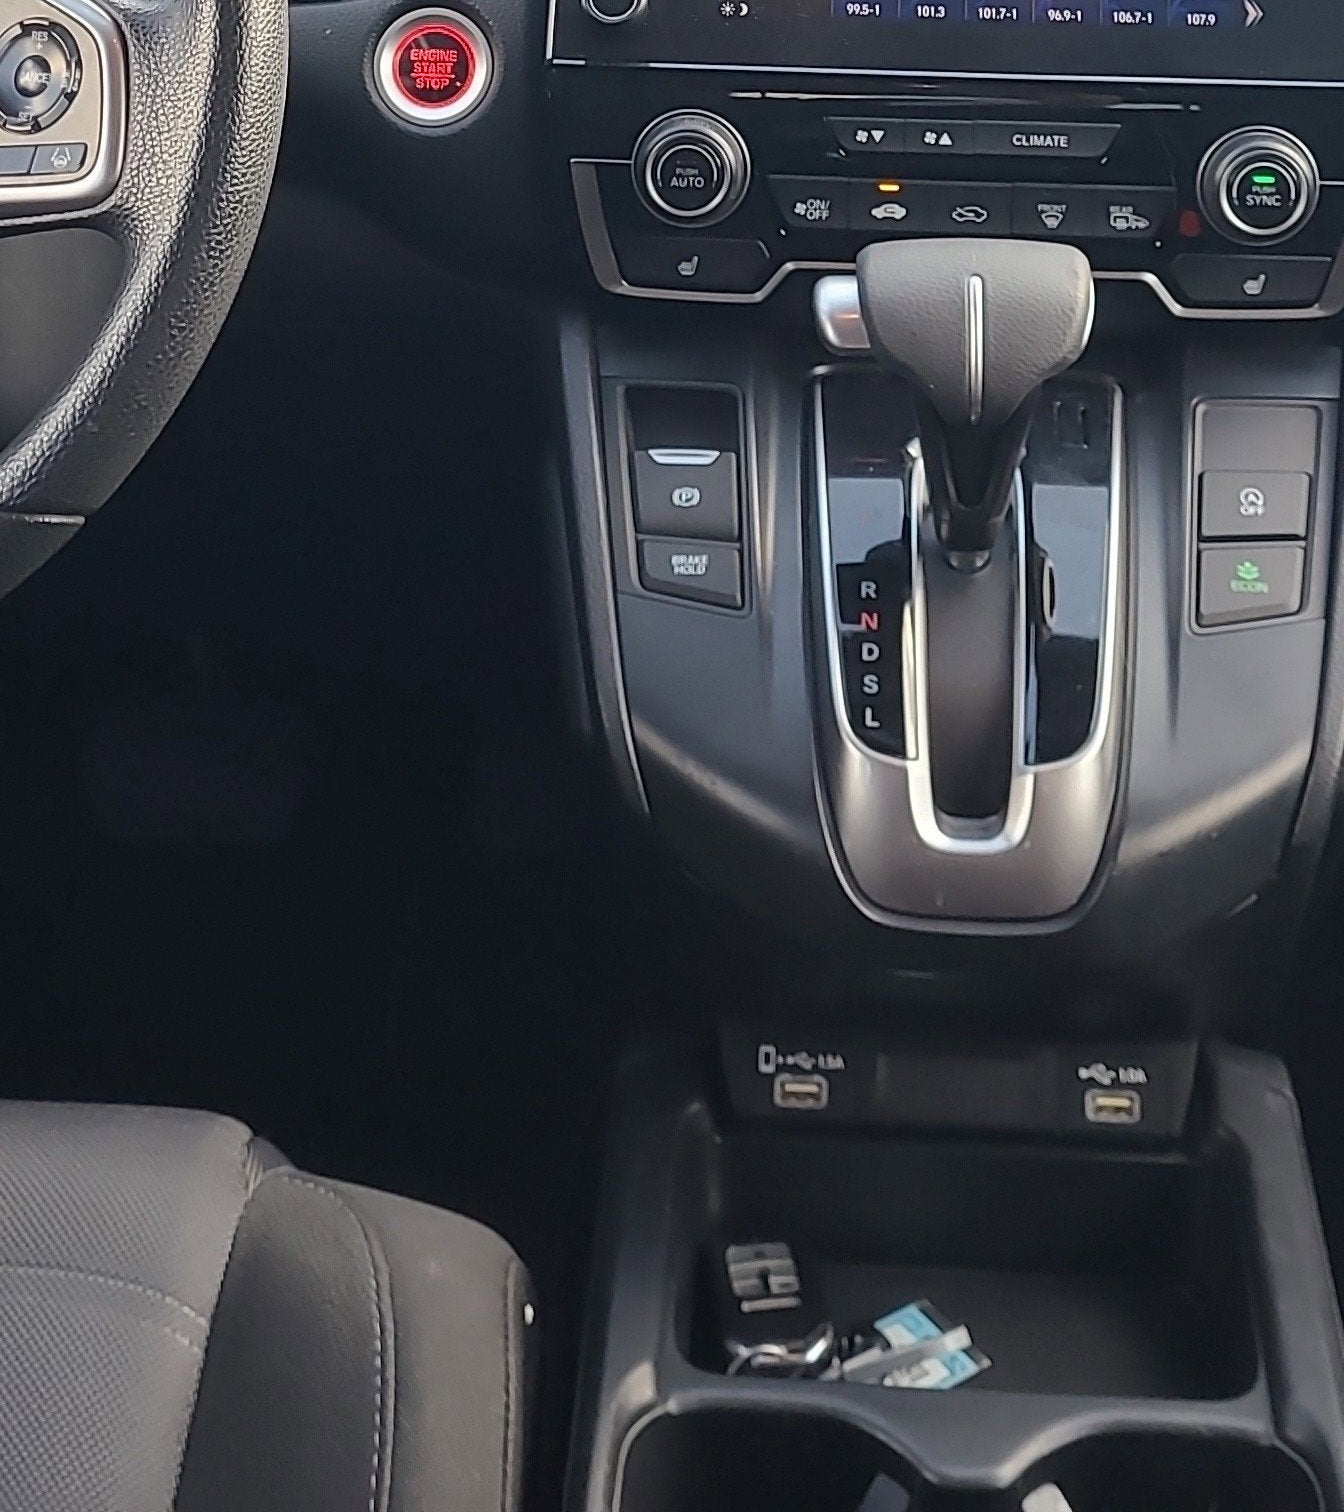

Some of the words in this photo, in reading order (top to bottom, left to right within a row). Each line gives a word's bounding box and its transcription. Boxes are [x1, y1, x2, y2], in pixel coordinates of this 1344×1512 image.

[846, 3, 881, 19] 99.5-1
[916, 4, 946, 19] 101.3
[977, 5, 1018, 21] 101.7-1
[1047, 7, 1083, 24] 96.9-1
[1112, 10, 1153, 26] 106.7-1
[1186, 12, 1216, 27] 107.9
[31, 30, 49, 42] RES
[409, 48, 458, 62] ENGINE
[413, 61, 454, 74] START
[415, 77, 450, 90] STOP
[1012, 133, 1069, 148] CLIMATE
[670, 177, 705, 188] AUTO
[1037, 203, 1067, 213] FRONT
[1245, 195, 1282, 208] SYNC
[806, 210, 830, 221] OFF
[860, 580, 877, 599] R
[860, 612, 879, 631] N
[861, 642, 880, 662] D
[862, 674, 879, 695] S
[864, 706, 881, 728] L
